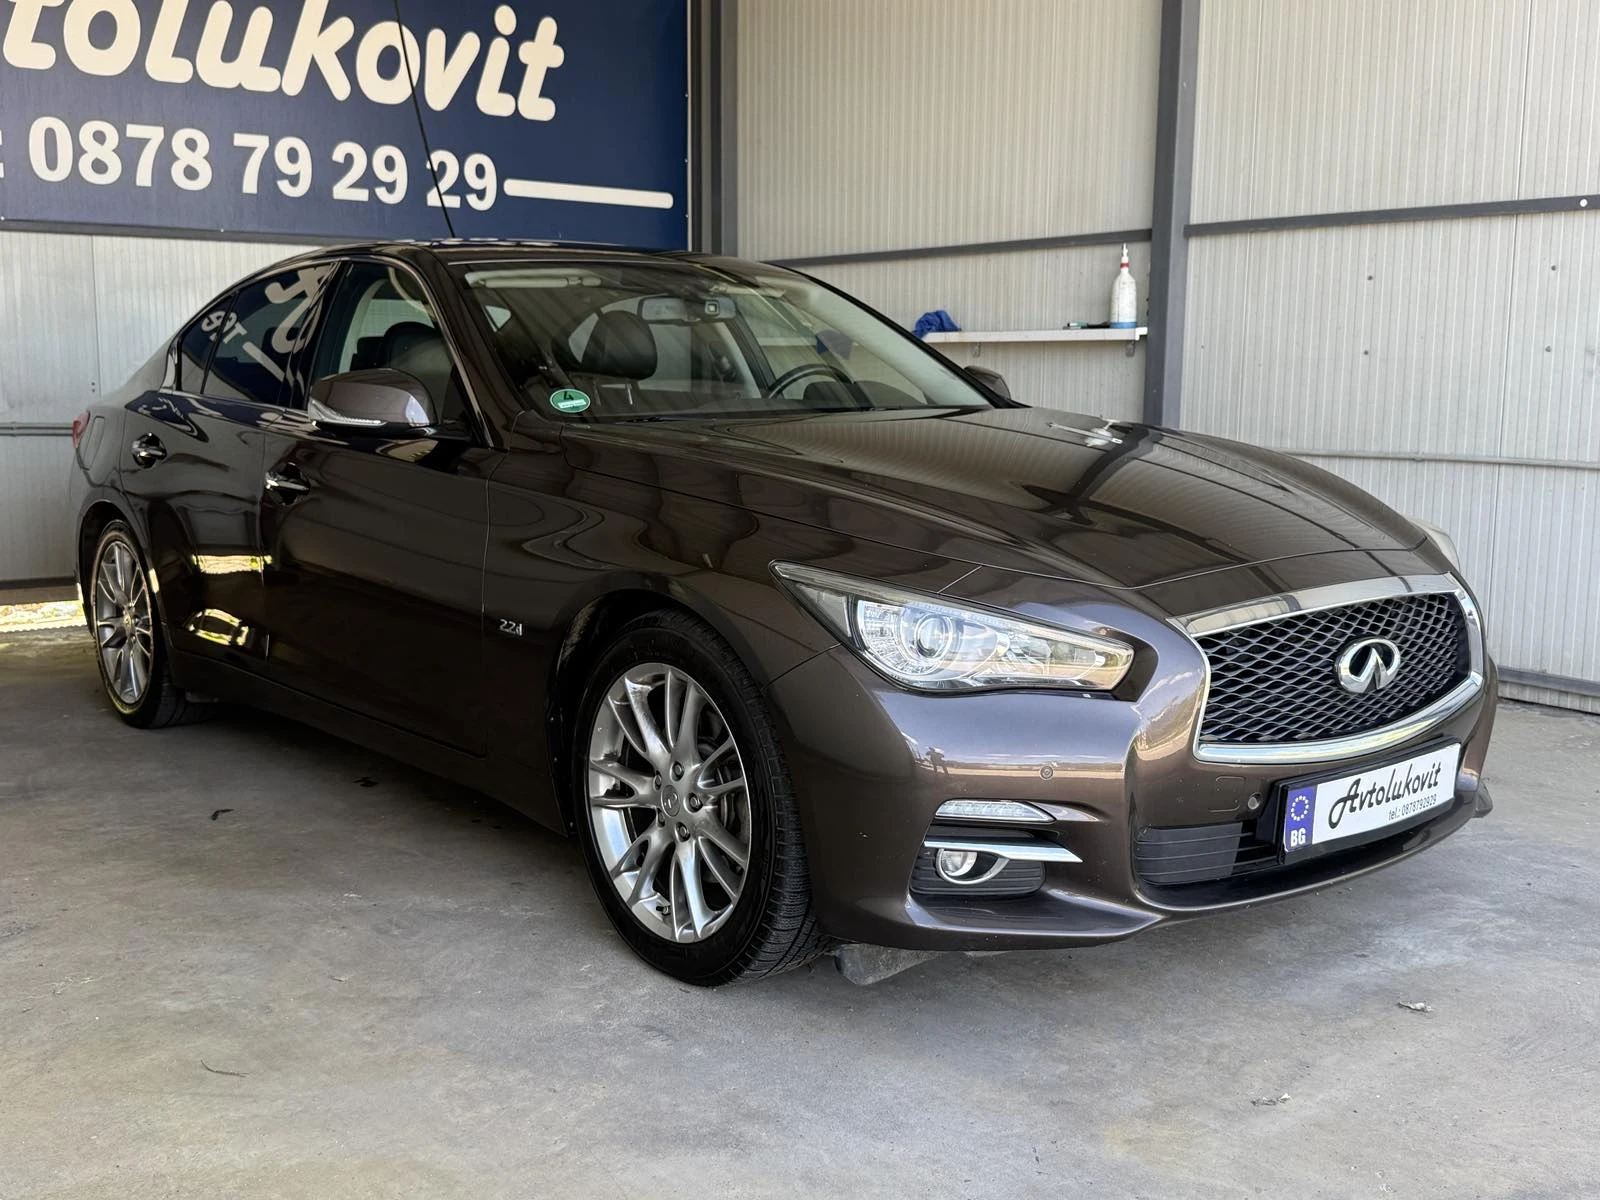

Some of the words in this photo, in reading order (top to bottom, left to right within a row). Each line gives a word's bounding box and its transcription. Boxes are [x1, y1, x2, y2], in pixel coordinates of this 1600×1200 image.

[28, 116, 213, 191] 0878
[233, 132, 313, 198] 79
[332, 141, 408, 205] 29
[426, 150, 498, 212] 29
[1328, 761, 1442, 829] Avtolukovit
[1290, 827, 1307, 847] BG
